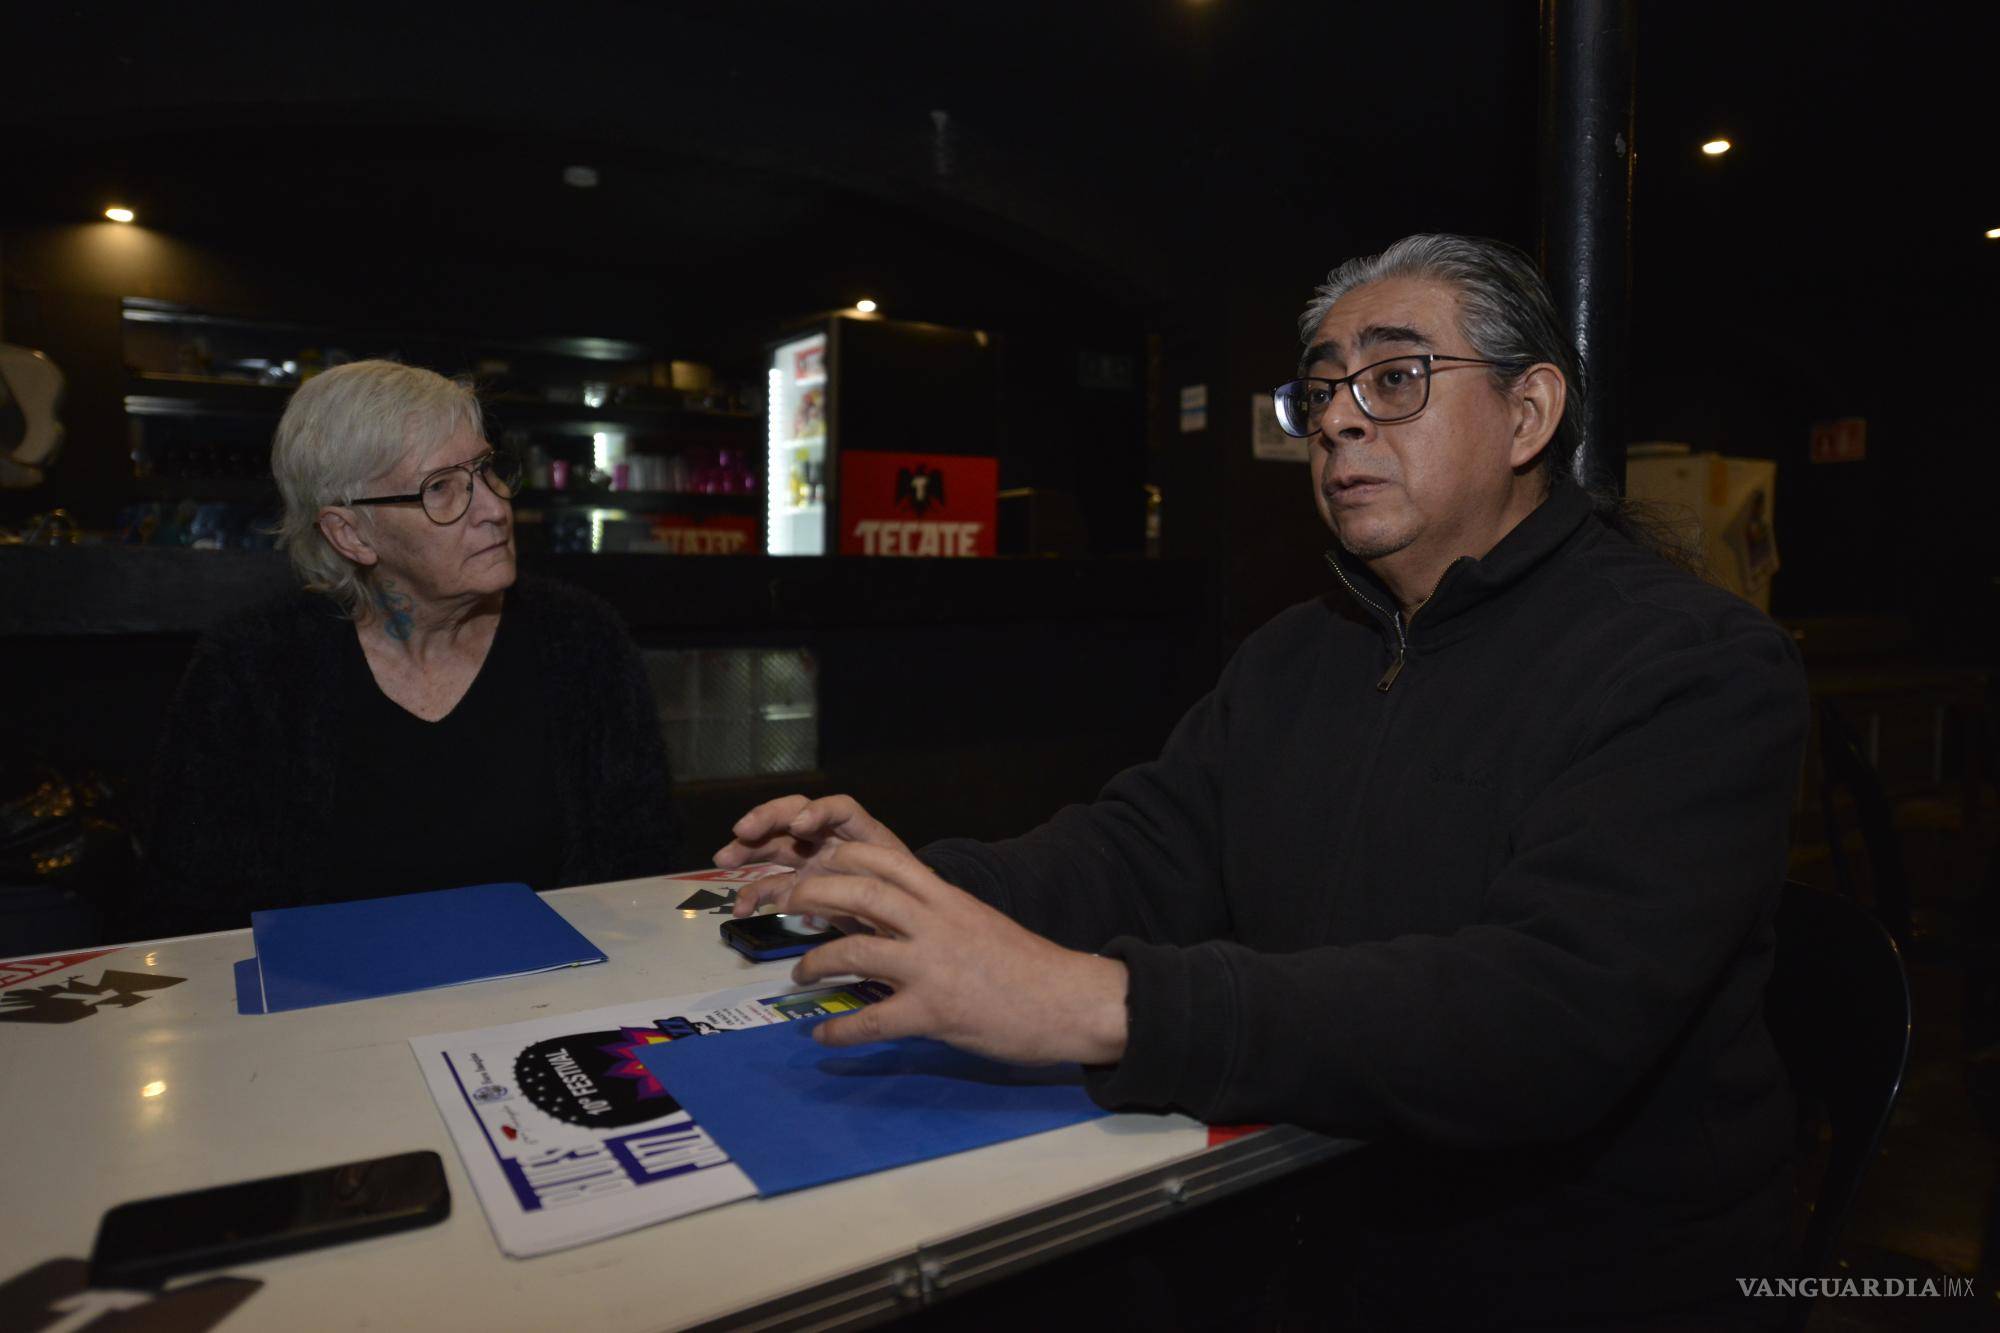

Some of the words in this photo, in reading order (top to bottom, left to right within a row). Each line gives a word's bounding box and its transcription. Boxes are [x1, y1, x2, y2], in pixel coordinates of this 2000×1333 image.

[852, 521, 984, 557] TECATE
[545, 1047, 599, 1097] FESTIVAL
[518, 1142, 631, 1206] BLUES
[623, 1127, 731, 1174] JAZZ
